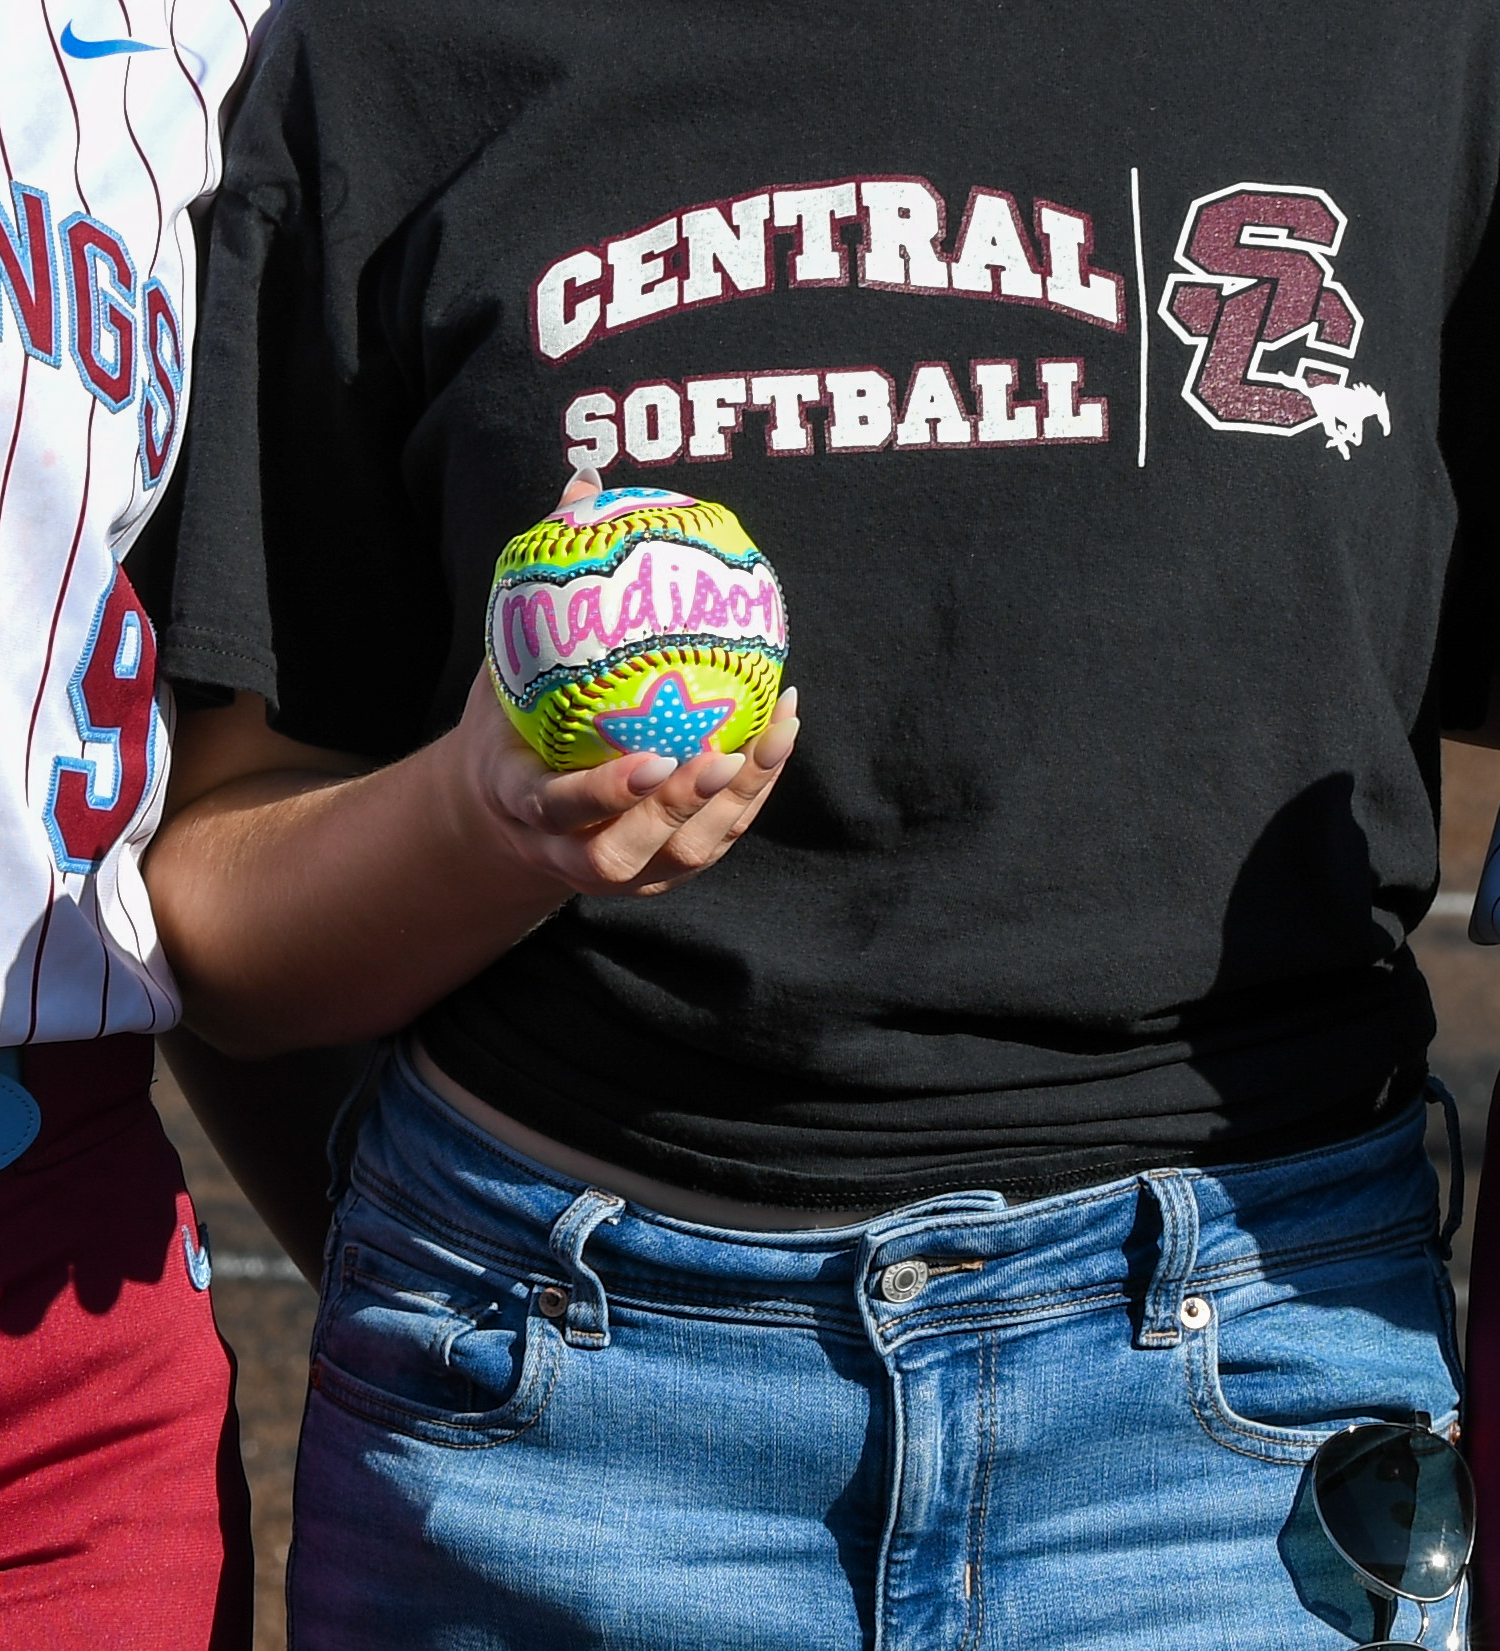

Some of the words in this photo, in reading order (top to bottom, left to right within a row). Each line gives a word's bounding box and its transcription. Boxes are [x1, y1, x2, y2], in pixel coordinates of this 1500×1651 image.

[531, 173, 1128, 369] CENTRAL
[561, 356, 1110, 474] SOFTBALL
[41, 549, 158, 875] 9
